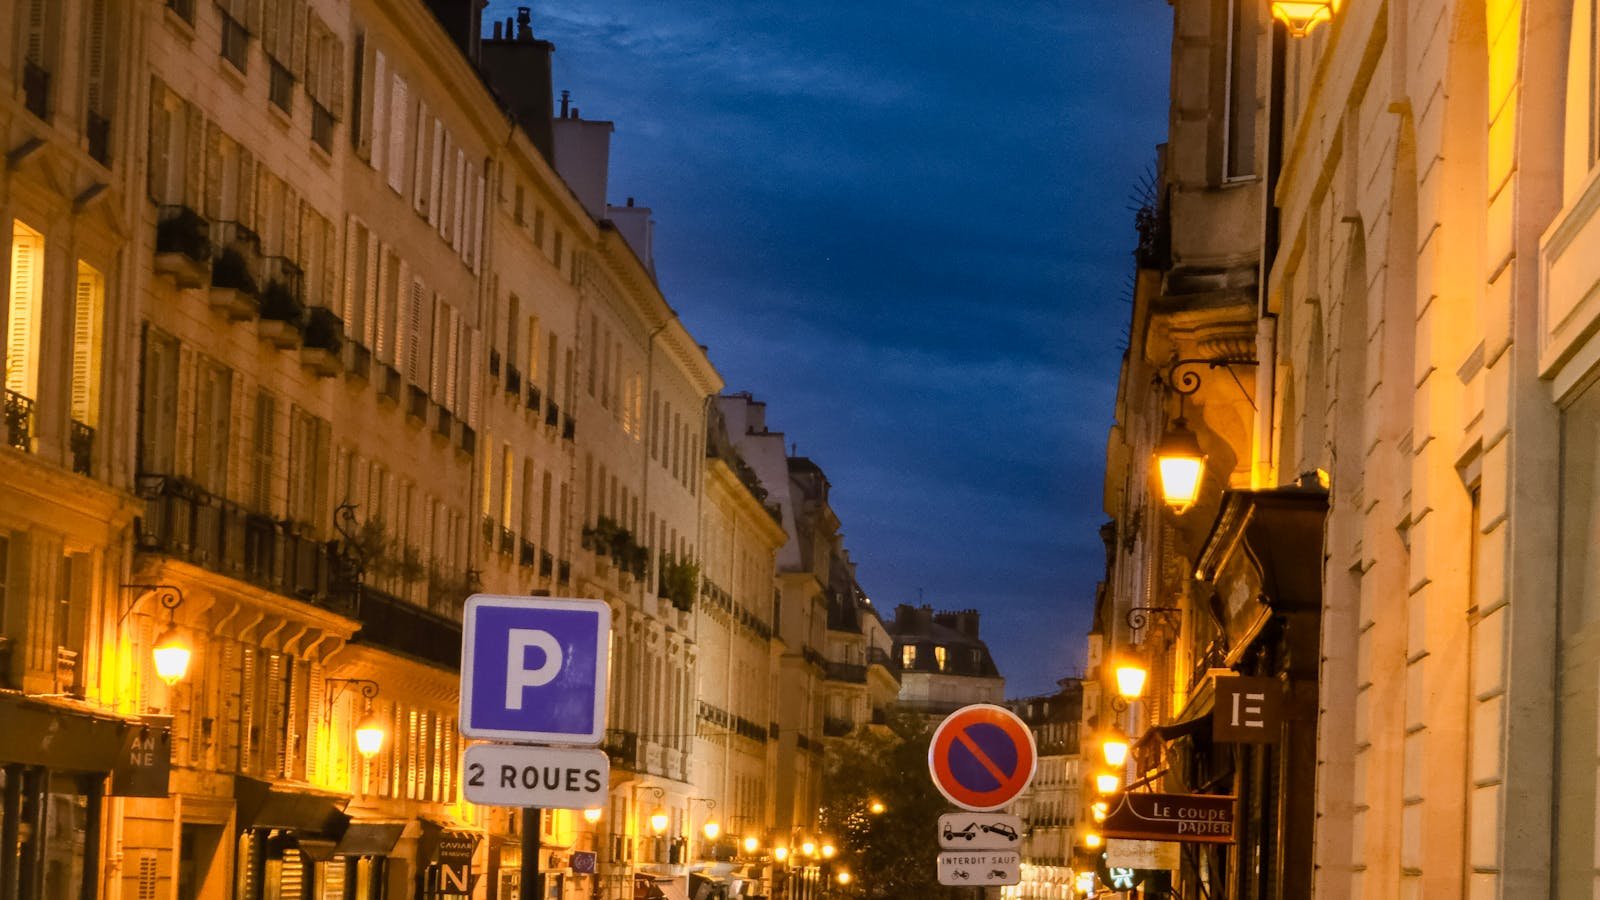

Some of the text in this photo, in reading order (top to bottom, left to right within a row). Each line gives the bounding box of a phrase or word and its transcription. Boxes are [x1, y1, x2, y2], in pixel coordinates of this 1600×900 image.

[505, 628, 563, 710] P
[131, 736, 155, 751] AN
[130, 752, 153, 767] NE
[468, 763, 601, 792] 2 ROUES
[439, 841, 472, 849] CAVIAR
[942, 856, 1017, 865] INTERDIT SAUF
[440, 864, 468, 891] N
